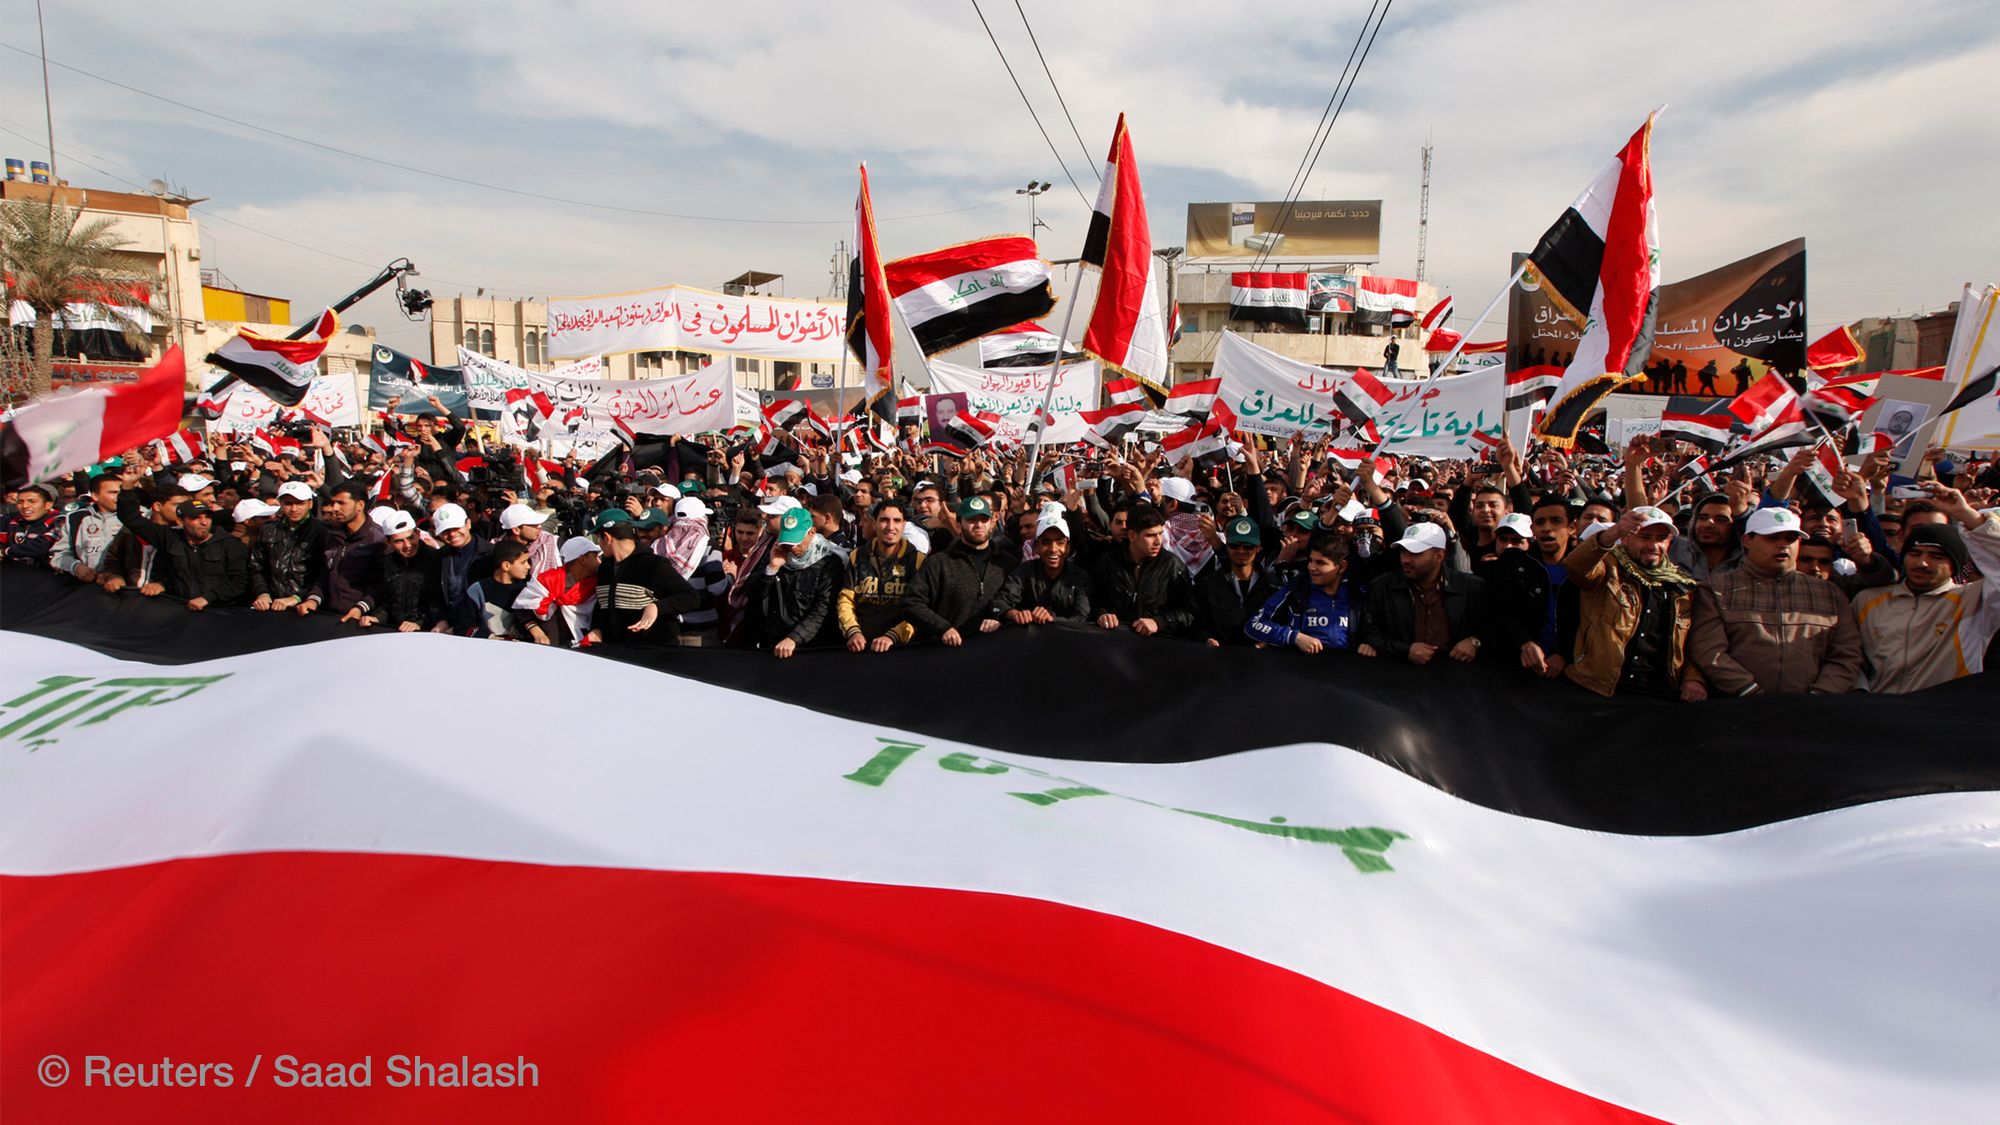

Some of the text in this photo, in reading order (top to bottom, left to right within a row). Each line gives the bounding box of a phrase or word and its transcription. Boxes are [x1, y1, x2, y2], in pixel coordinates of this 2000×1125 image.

[1349, 209, 1370, 220] جديد
[650, 301, 681, 322] العراق
[682, 303, 702, 337] في
[710, 303, 779, 343] المسلمون
[1654, 300, 1804, 335] الاخوان المسل
[1532, 328, 1561, 338] المحتل
[1685, 338, 1730, 353] الشعب
[1733, 328, 1804, 348] يشاركون
[607, 389, 660, 420] العراق
[1240, 389, 1314, 425] للعراق
